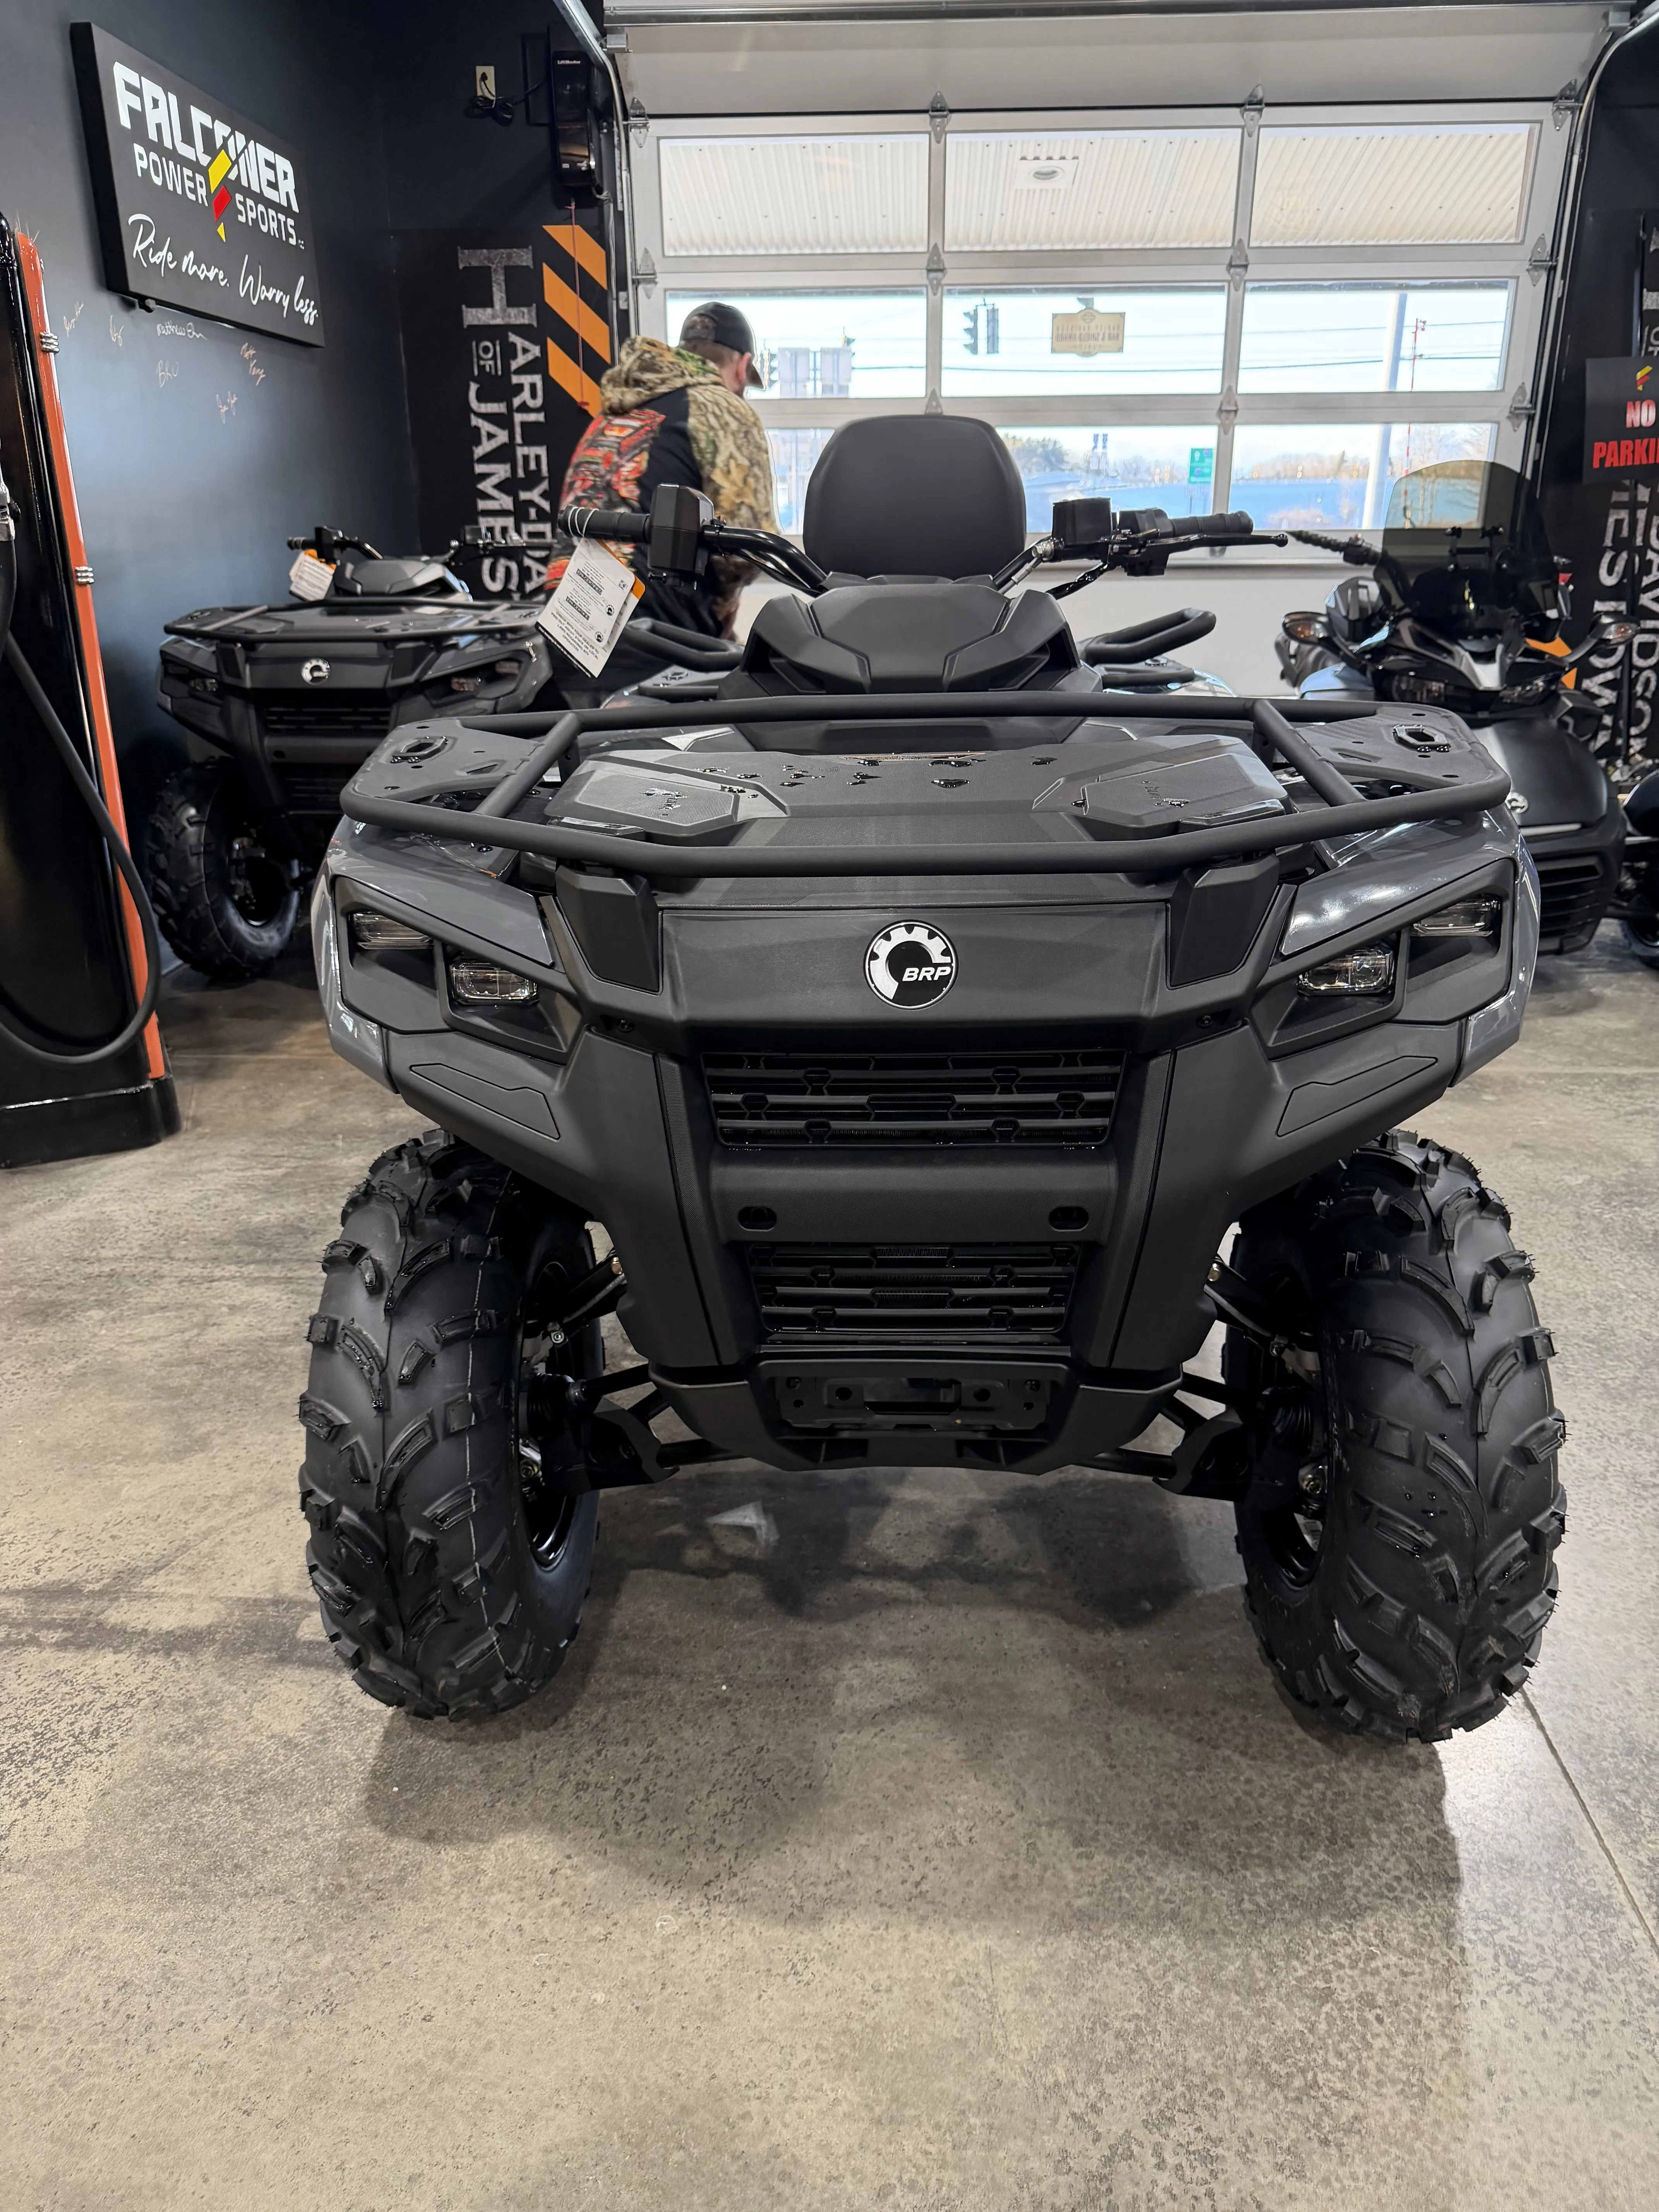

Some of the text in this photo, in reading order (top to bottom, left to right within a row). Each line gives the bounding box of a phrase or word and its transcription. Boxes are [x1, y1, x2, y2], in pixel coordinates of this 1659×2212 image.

[134, 143, 296, 246] POWER SPORTS
[128, 213, 177, 276] Ride
[239, 254, 290, 318] Worry
[1626, 399, 1656, 428] NO
[468, 340, 522, 601] OF JAMES
[1592, 437, 1659, 469] PARKI
[902, 966, 951, 982] BRP
